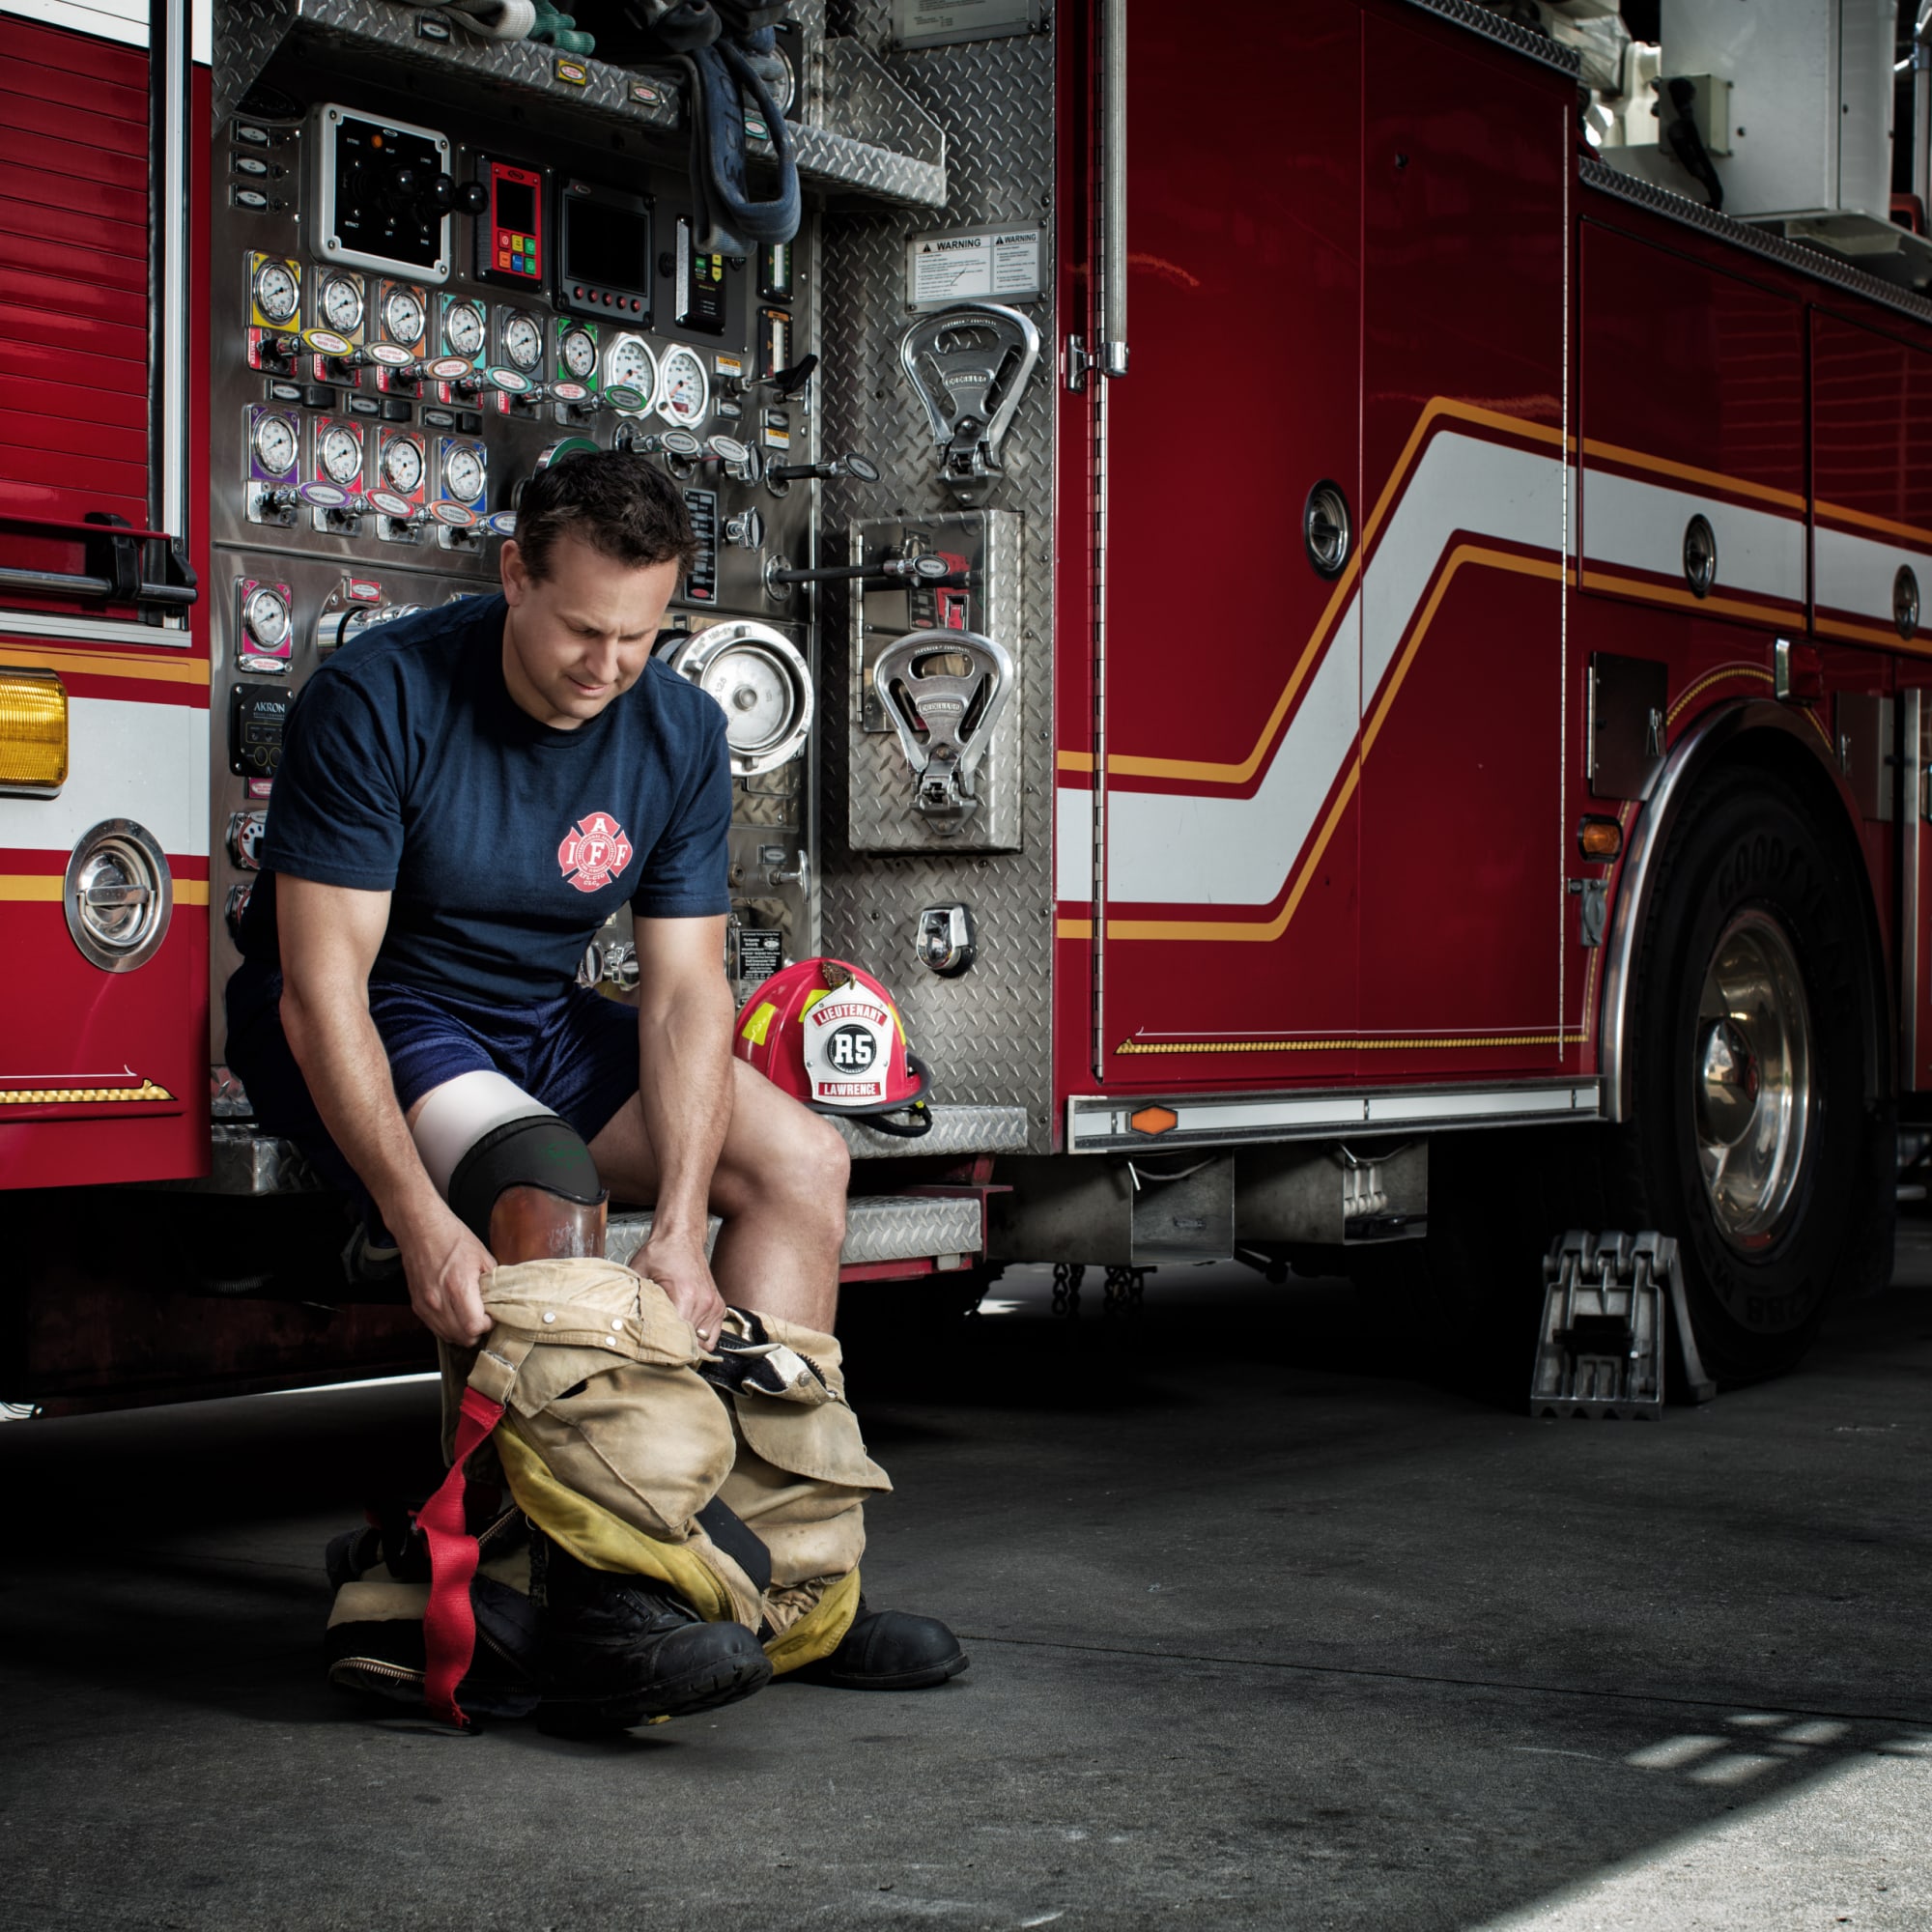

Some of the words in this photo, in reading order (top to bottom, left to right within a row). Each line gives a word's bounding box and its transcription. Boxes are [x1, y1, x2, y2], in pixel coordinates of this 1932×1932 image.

[1005, 234, 1037, 243] WARNING
[937, 239, 980, 251] WARNING
[254, 702, 285, 713] AKRON
[817, 1005, 883, 1024] LIEUTENANT
[824, 1084, 876, 1095] LAWRENCE
